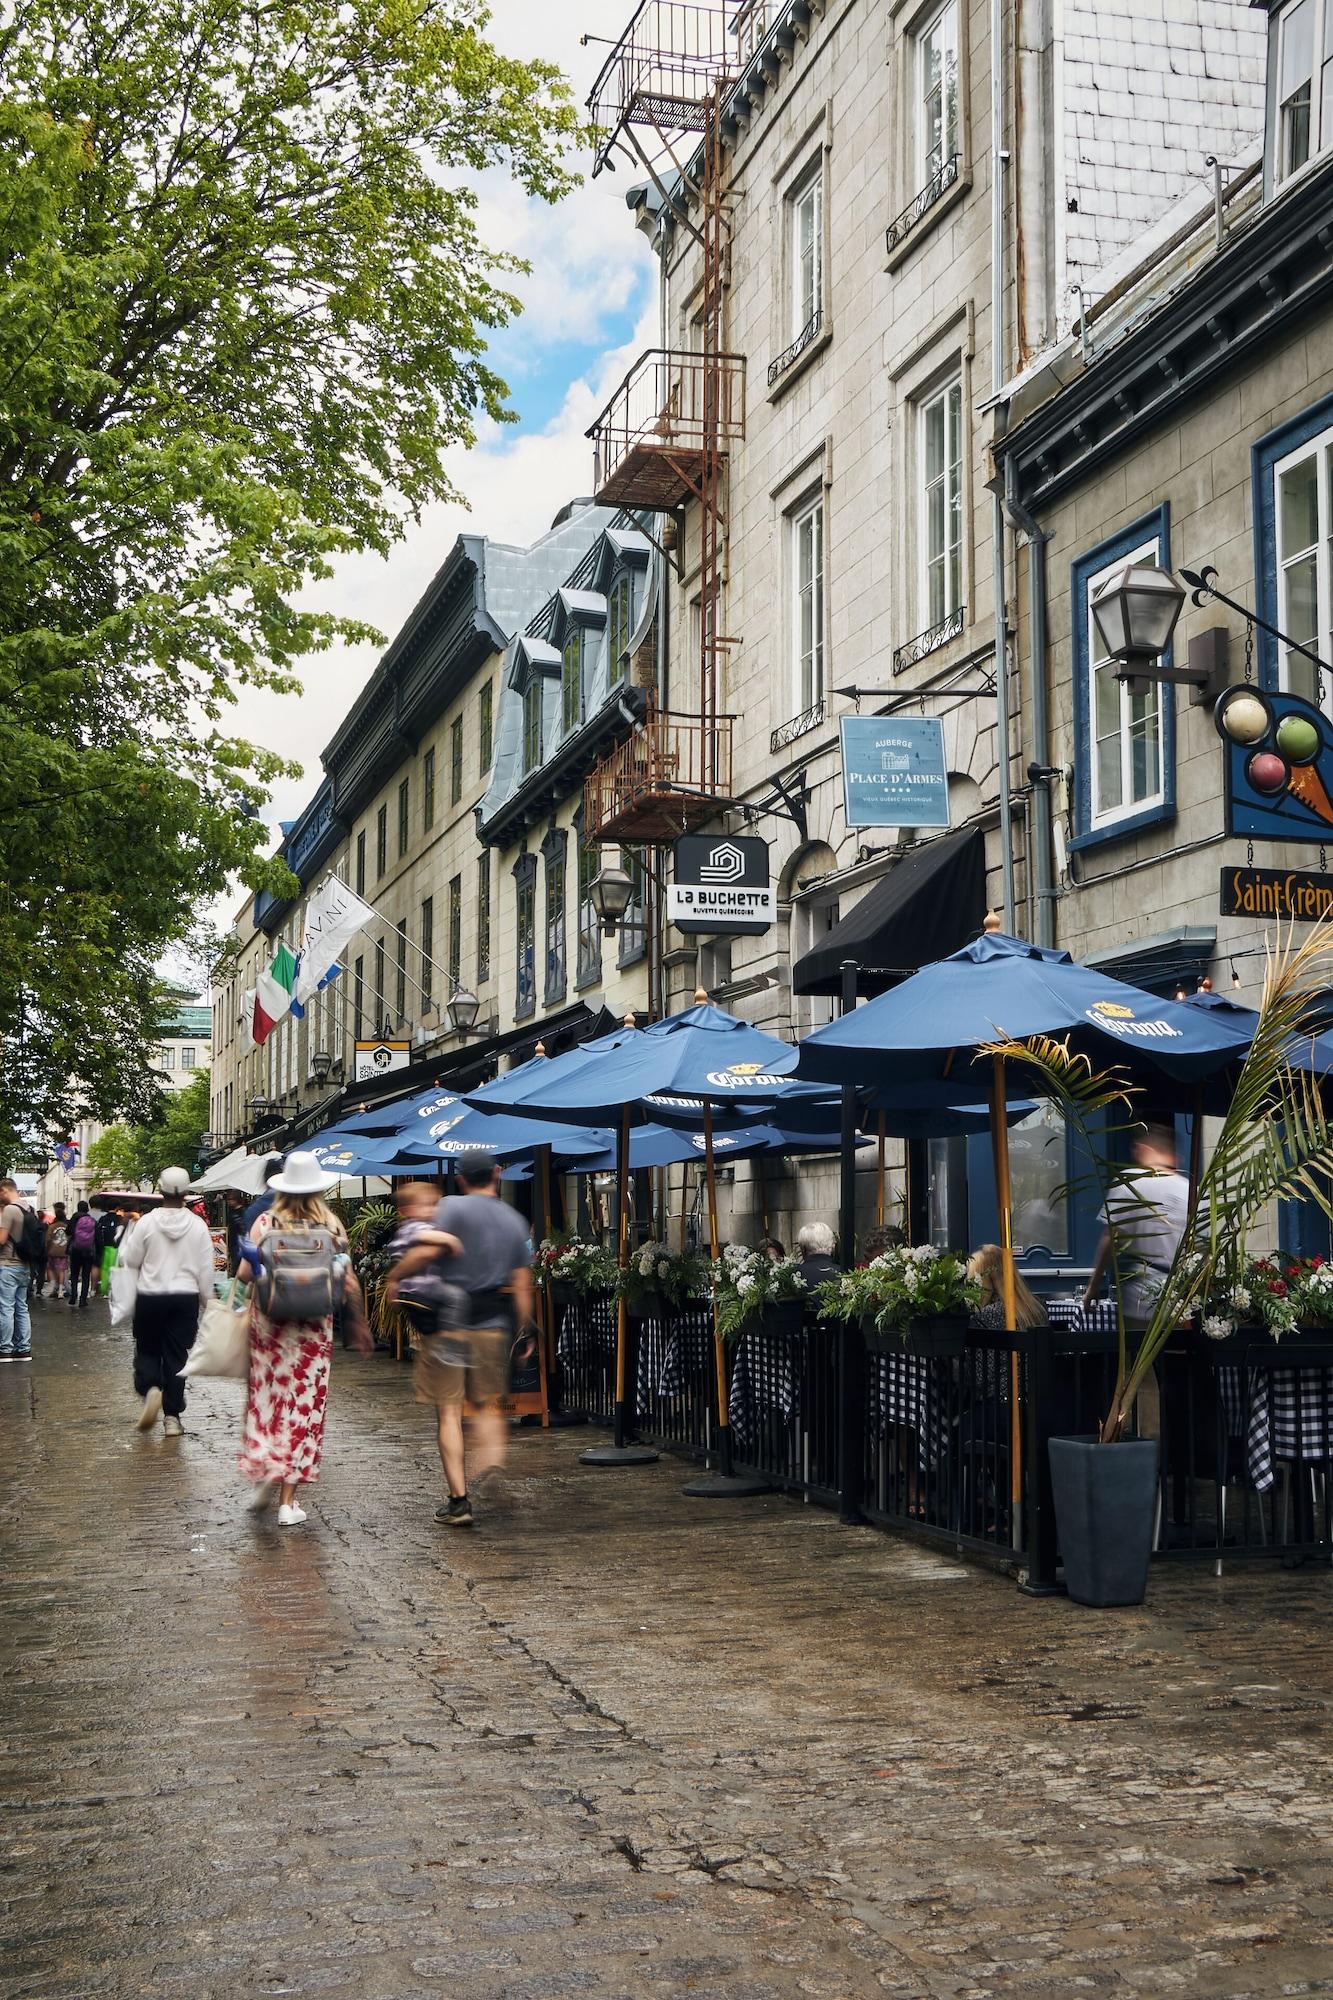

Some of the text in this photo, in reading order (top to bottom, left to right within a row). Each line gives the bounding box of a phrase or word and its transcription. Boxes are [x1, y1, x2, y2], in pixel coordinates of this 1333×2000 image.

[875, 739, 913, 749] AUBERGE
[850, 772, 943, 784] PLACE D'ARMES
[677, 890, 694, 903] La
[1085, 1009, 1178, 1037] Corona
[641, 1095, 720, 1109] Coron
